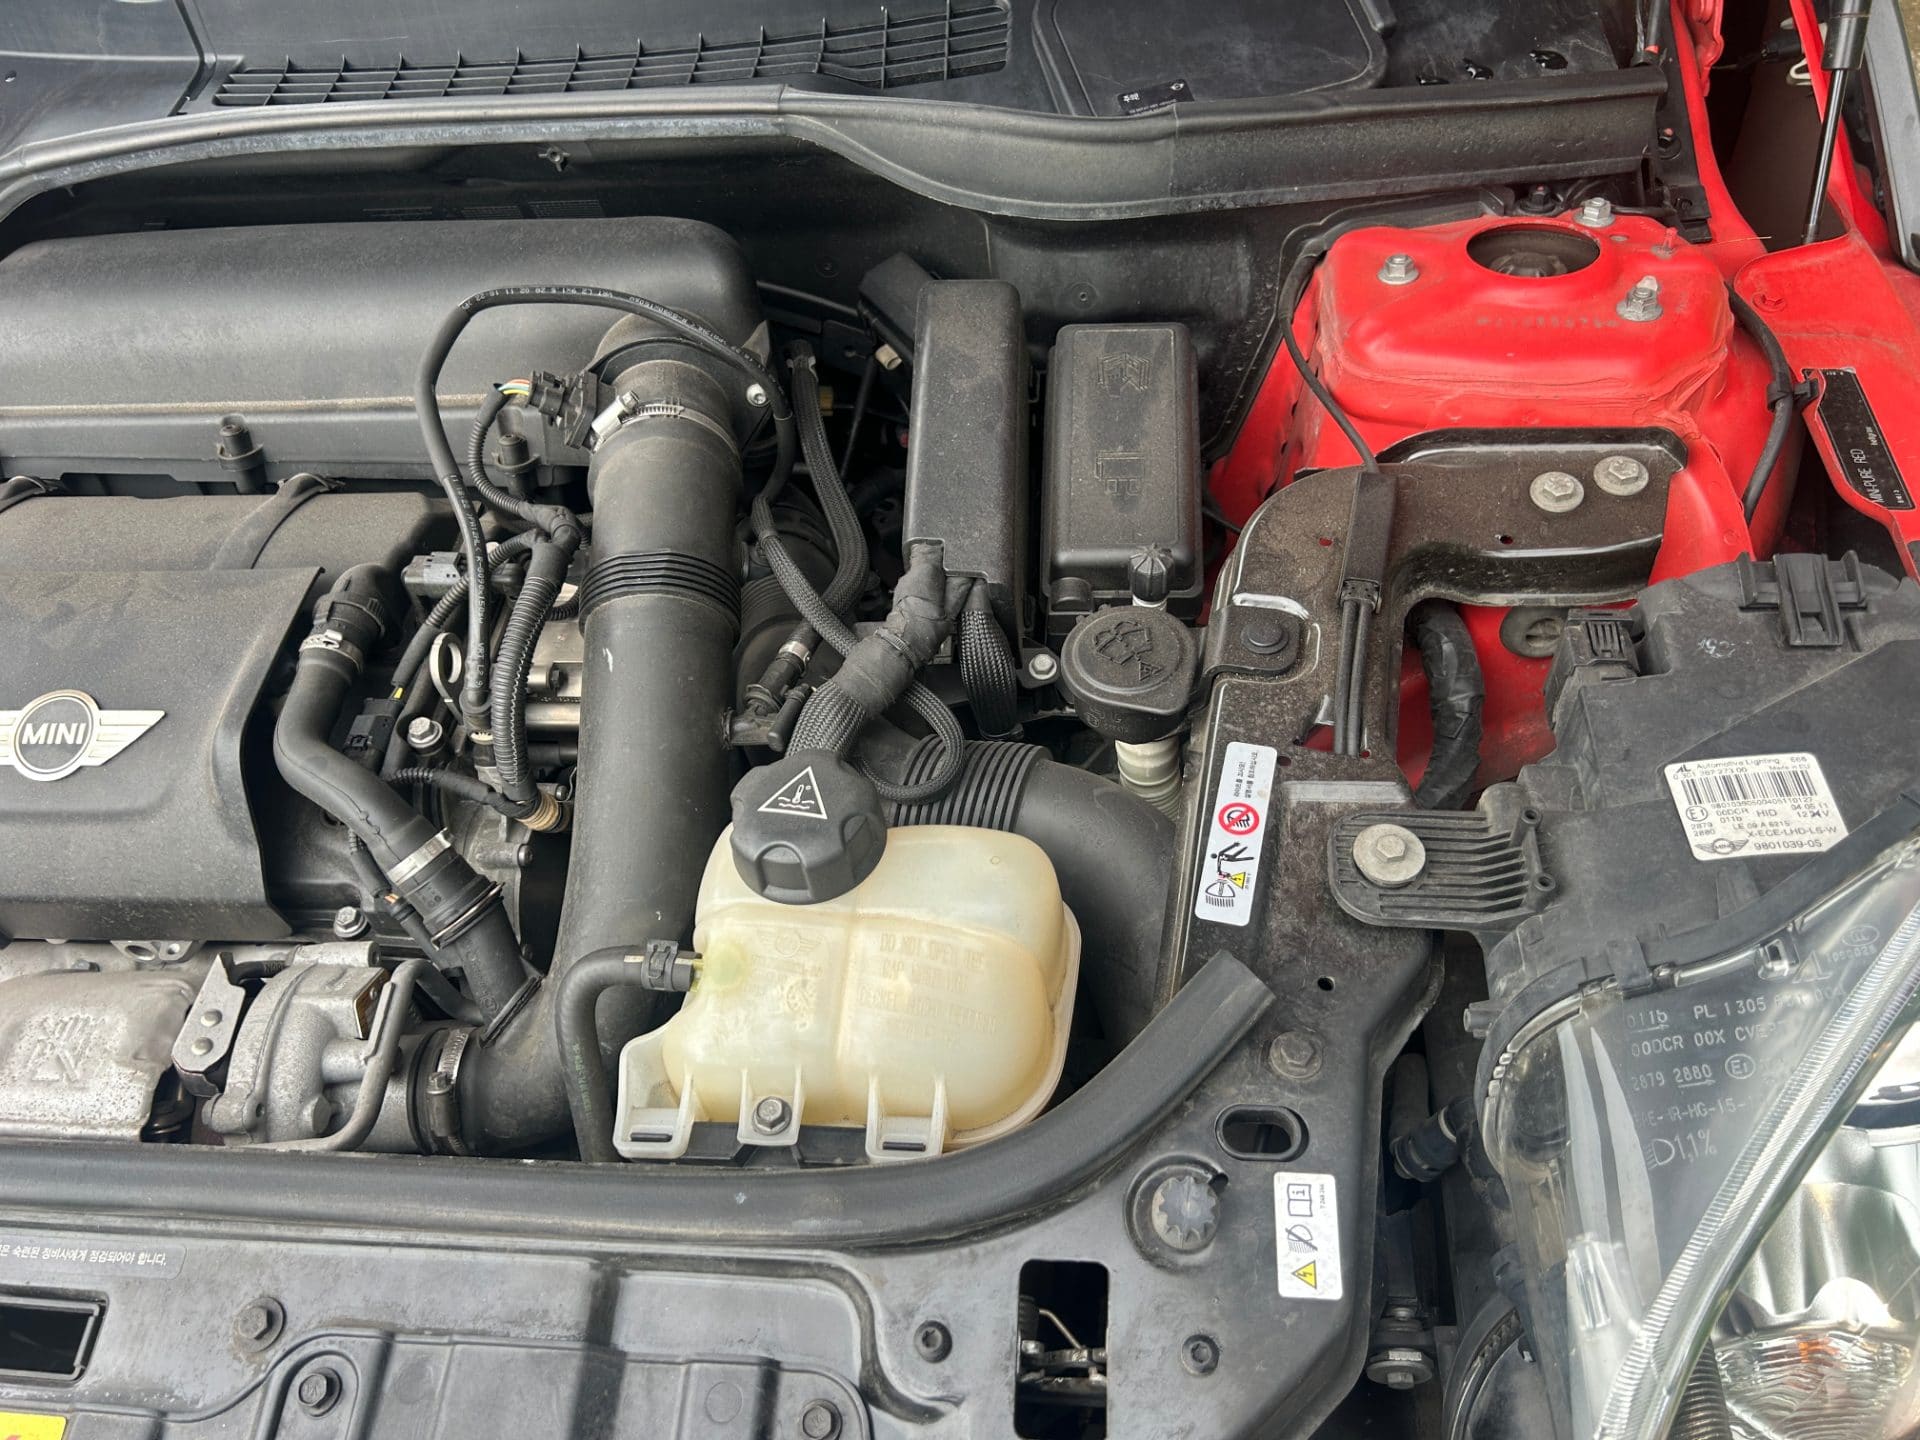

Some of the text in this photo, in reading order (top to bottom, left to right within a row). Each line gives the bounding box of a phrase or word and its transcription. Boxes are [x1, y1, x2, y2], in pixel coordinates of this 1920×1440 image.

[1850, 448, 1868, 464] RED
[21, 722, 87, 745] MINI
[1697, 760, 1744, 770] Automotive
[1746, 757, 1780, 767] Lighting
[1756, 808, 1778, 817] HID
[1693, 1005, 1716, 1020] PL
